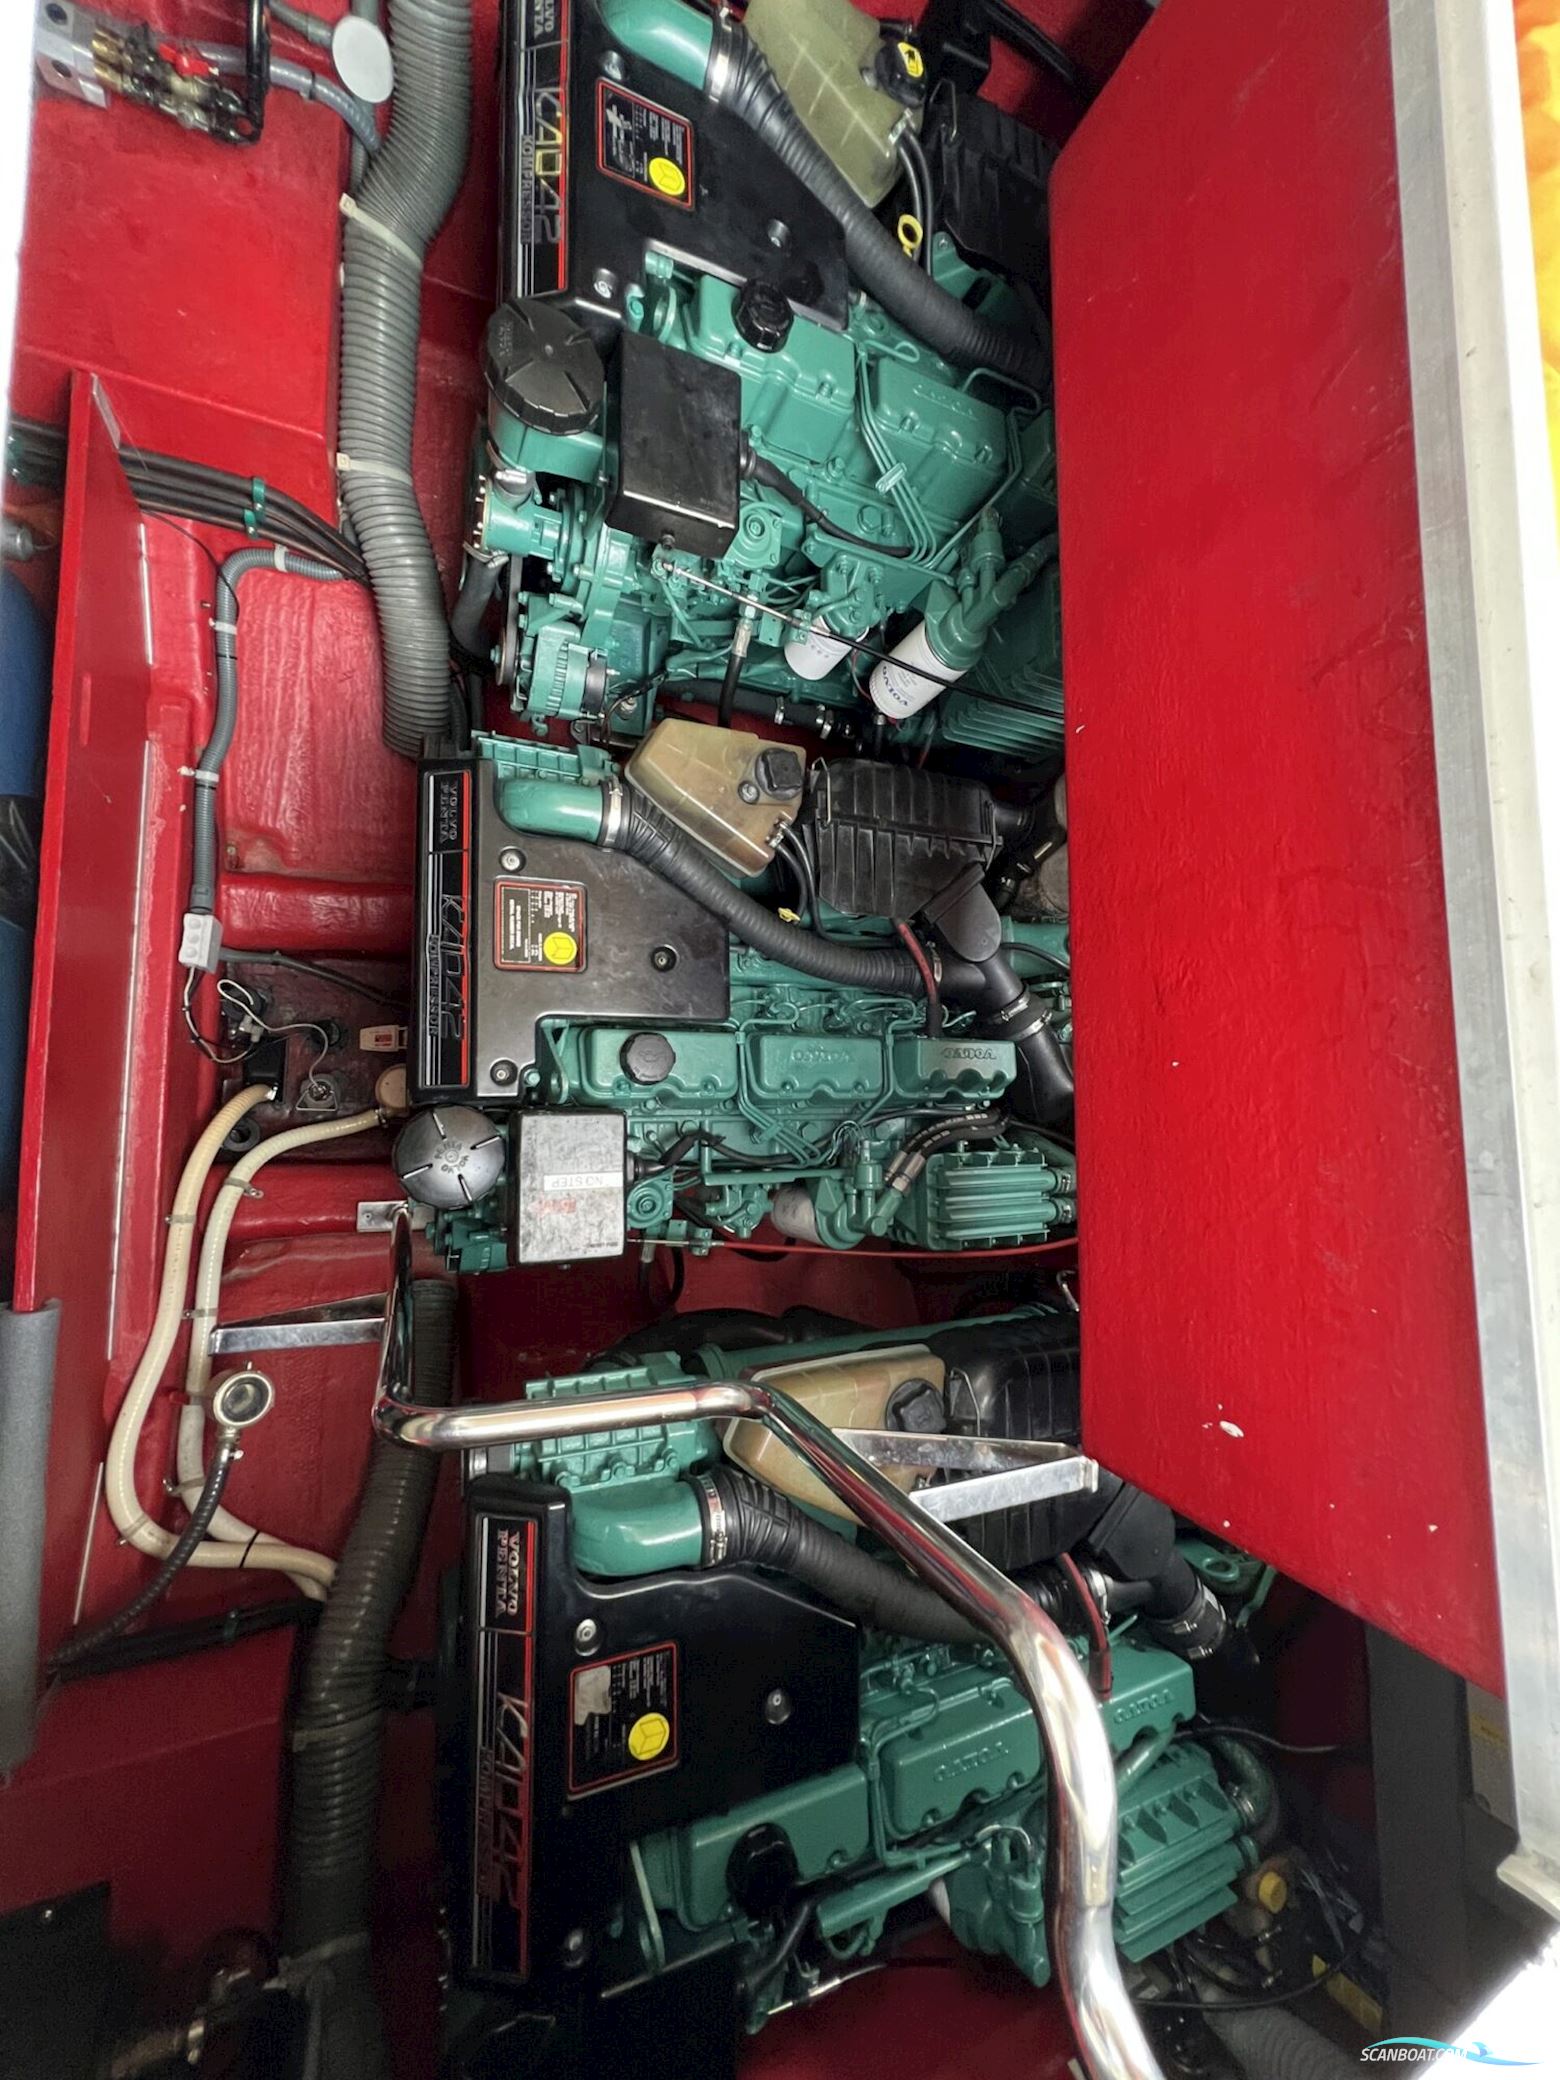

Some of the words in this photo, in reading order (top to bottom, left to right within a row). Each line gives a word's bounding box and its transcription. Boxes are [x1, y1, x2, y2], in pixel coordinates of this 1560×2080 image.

[522, 134, 534, 244] KOMPRESSOR
[535, 89, 563, 242] KAD42
[880, 664, 911, 708] VOLVO
[440, 781, 450, 843] PENTA
[449, 783, 458, 841] VOLVO
[428, 935, 439, 1036] KOMPRESSOR
[441, 895, 465, 1041] KAD42
[942, 1047, 996, 1060] VOLVO
[441, 1155, 470, 1174] VOLVO
[551, 1177, 584, 1188] STEP
[585, 1176, 604, 1187] NO
[495, 1529, 508, 1618] PENTA
[507, 1531, 521, 1616] VOLVO
[1113, 1687, 1175, 1724] VOLVO
[933, 1739, 1010, 1785] VOLVO
